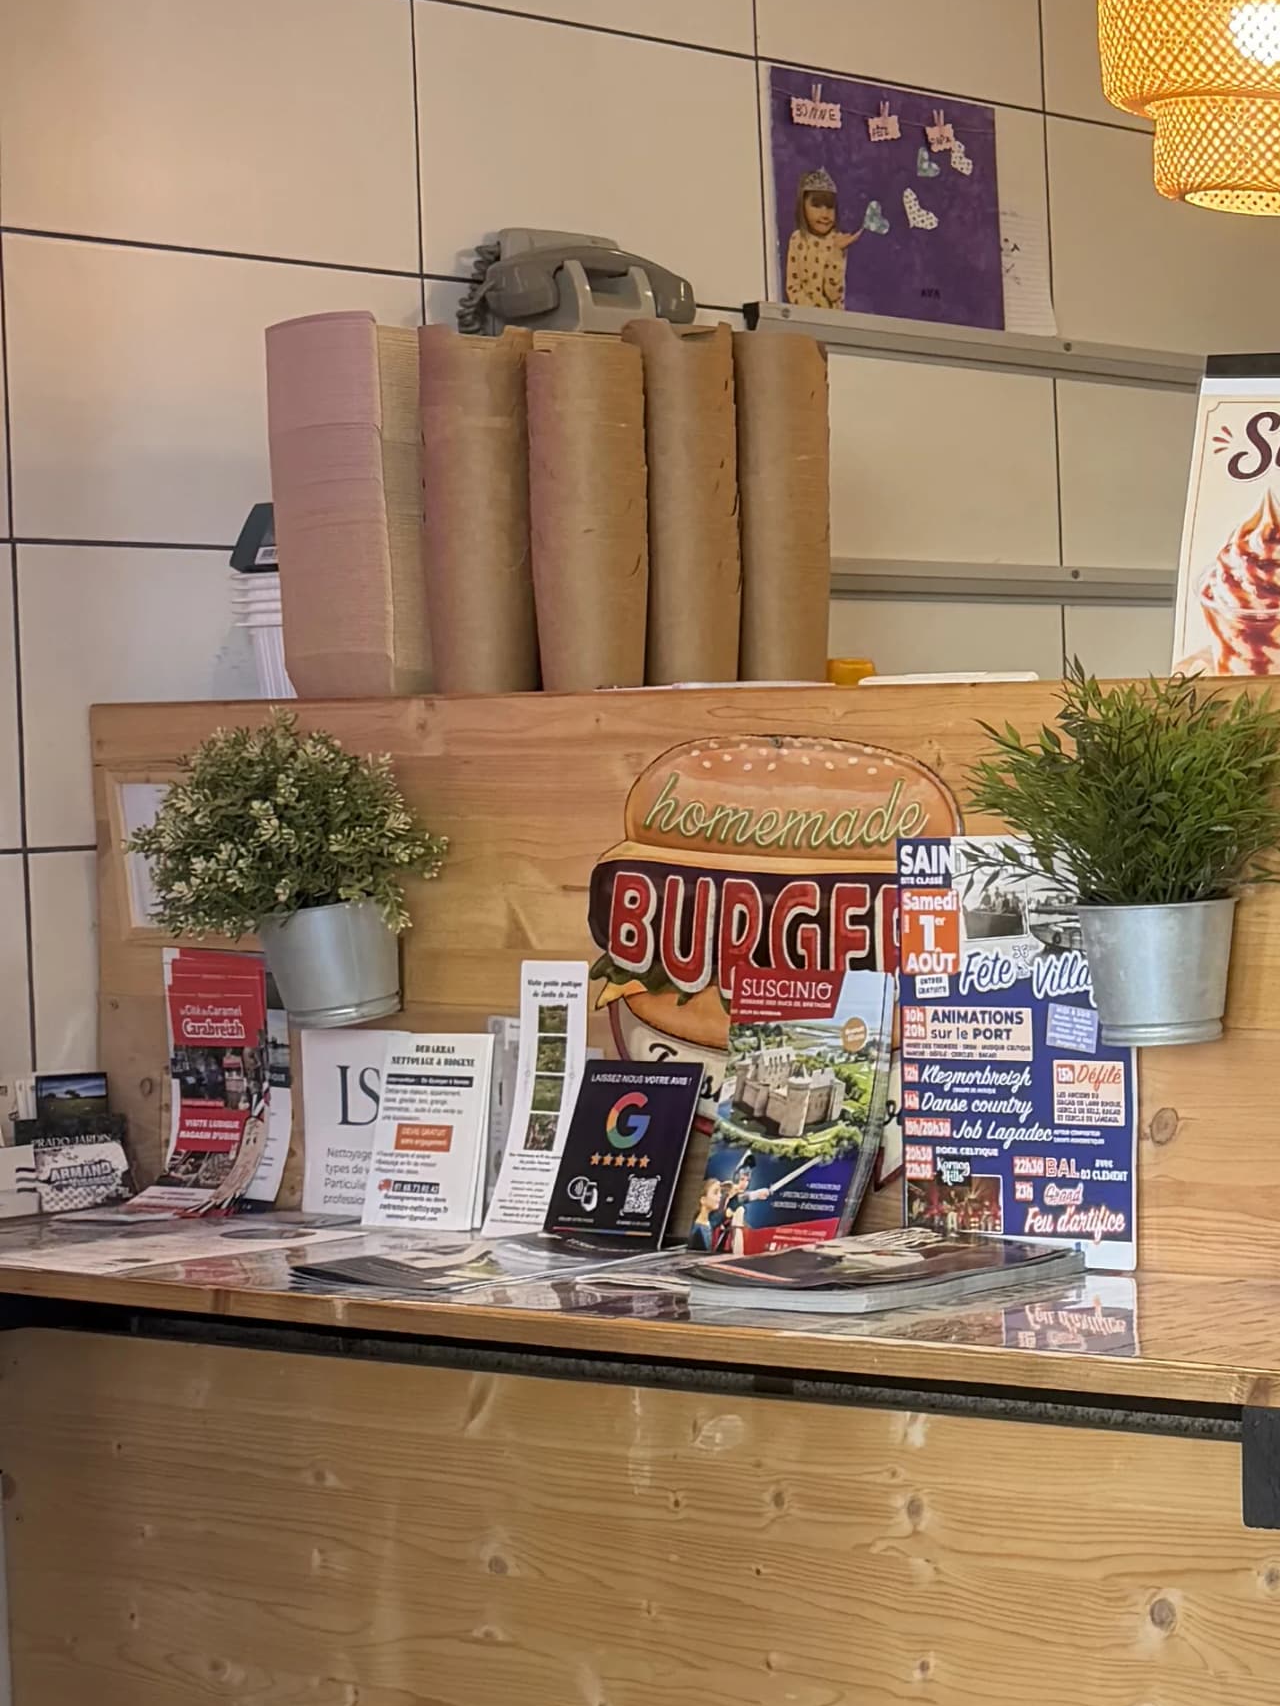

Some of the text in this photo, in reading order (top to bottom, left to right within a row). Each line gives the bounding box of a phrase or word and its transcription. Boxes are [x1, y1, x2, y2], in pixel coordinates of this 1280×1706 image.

[645, 771, 1079, 849] homemade
[902, 890, 957, 911] Samedi
[607, 870, 901, 999] BURGE
[906, 948, 957, 973] AOÛT
[962, 951, 1012, 991] Fête
[741, 977, 833, 1001] SUSCINIO
[1033, 950, 1093, 1001] Villa
[930, 1009, 1024, 1025] ANIMATIONS
[930, 1026, 1013, 1041] sur le PORT
[1076, 1064, 1123, 1092] Défilé
[920, 1092, 1033, 1123] Danse country
[952, 1119, 982, 1141] Job
[986, 1120, 1053, 1149] Lagadec
[1044, 1157, 1080, 1178] BAL
[1024, 1205, 1054, 1233] Feu
